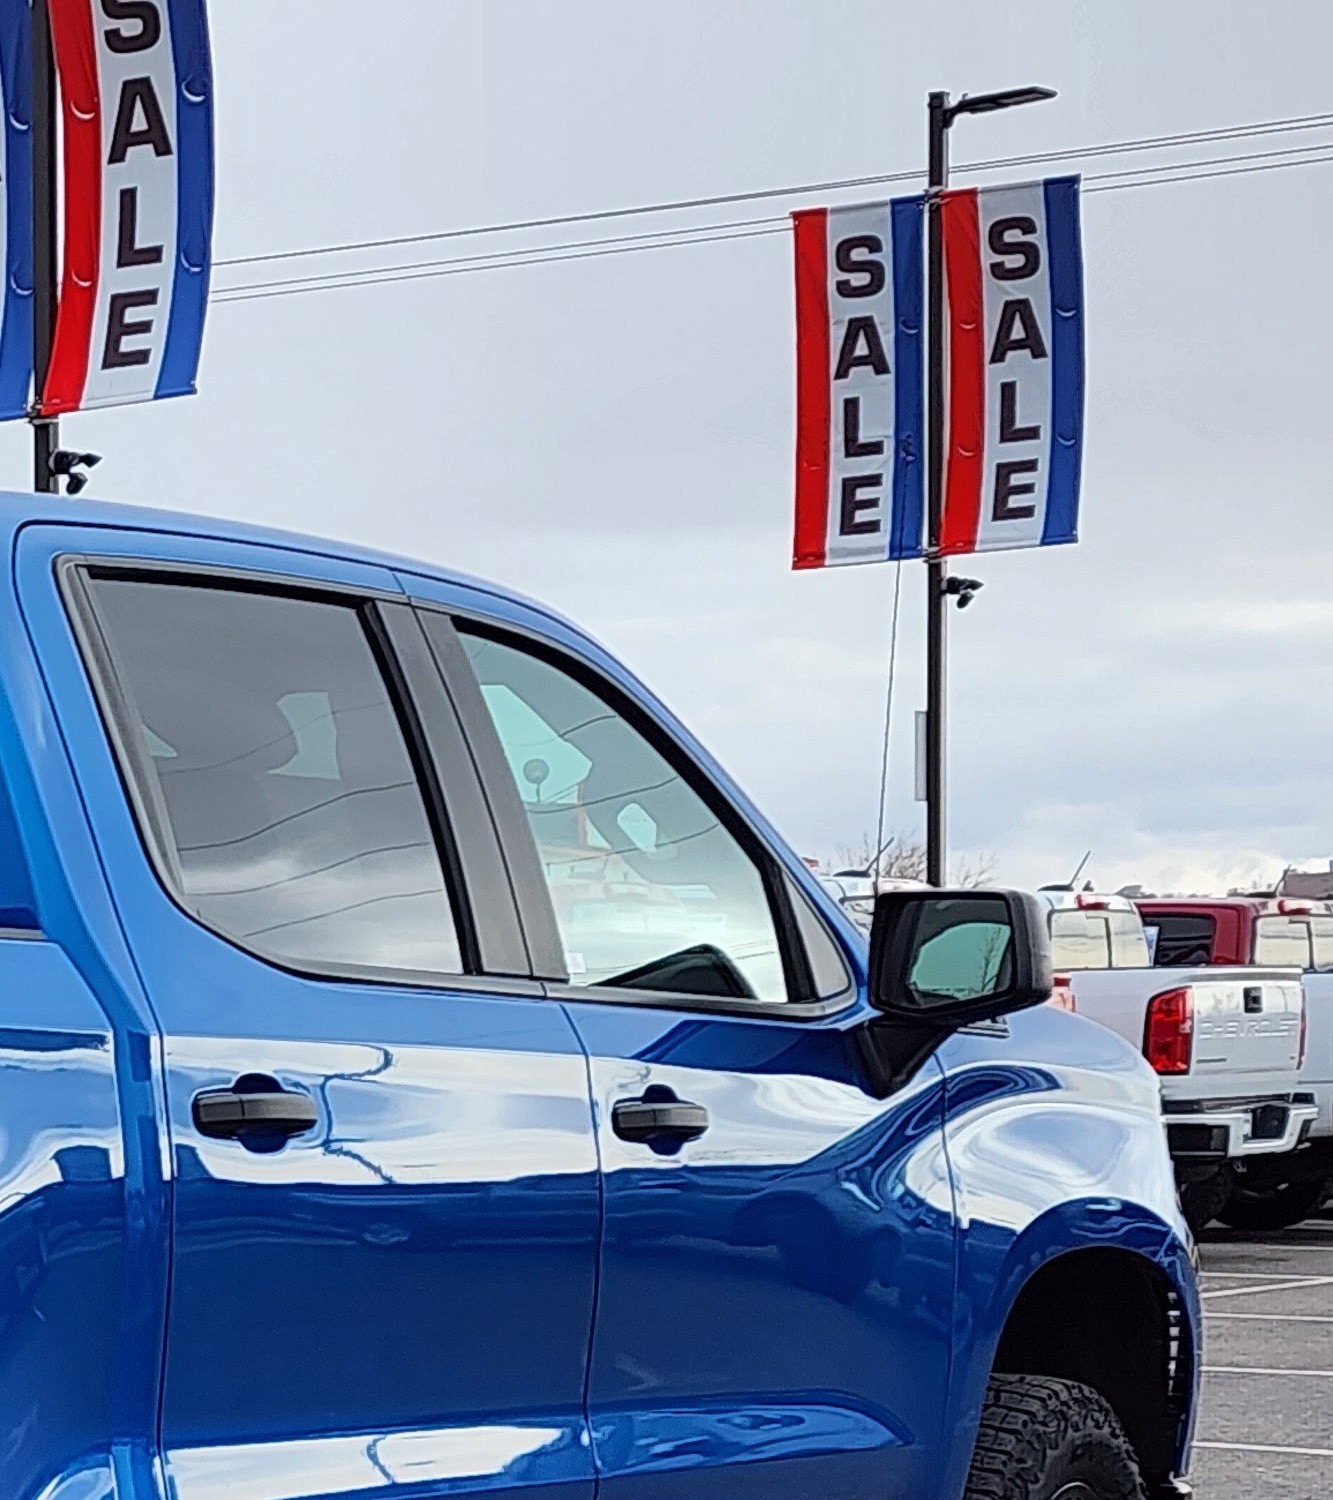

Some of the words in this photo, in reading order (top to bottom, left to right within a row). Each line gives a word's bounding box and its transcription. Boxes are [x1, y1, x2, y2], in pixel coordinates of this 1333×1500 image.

[101, 0, 172, 370] SALE
[834, 235, 891, 536] SALE
[989, 216, 1048, 522] SALE
